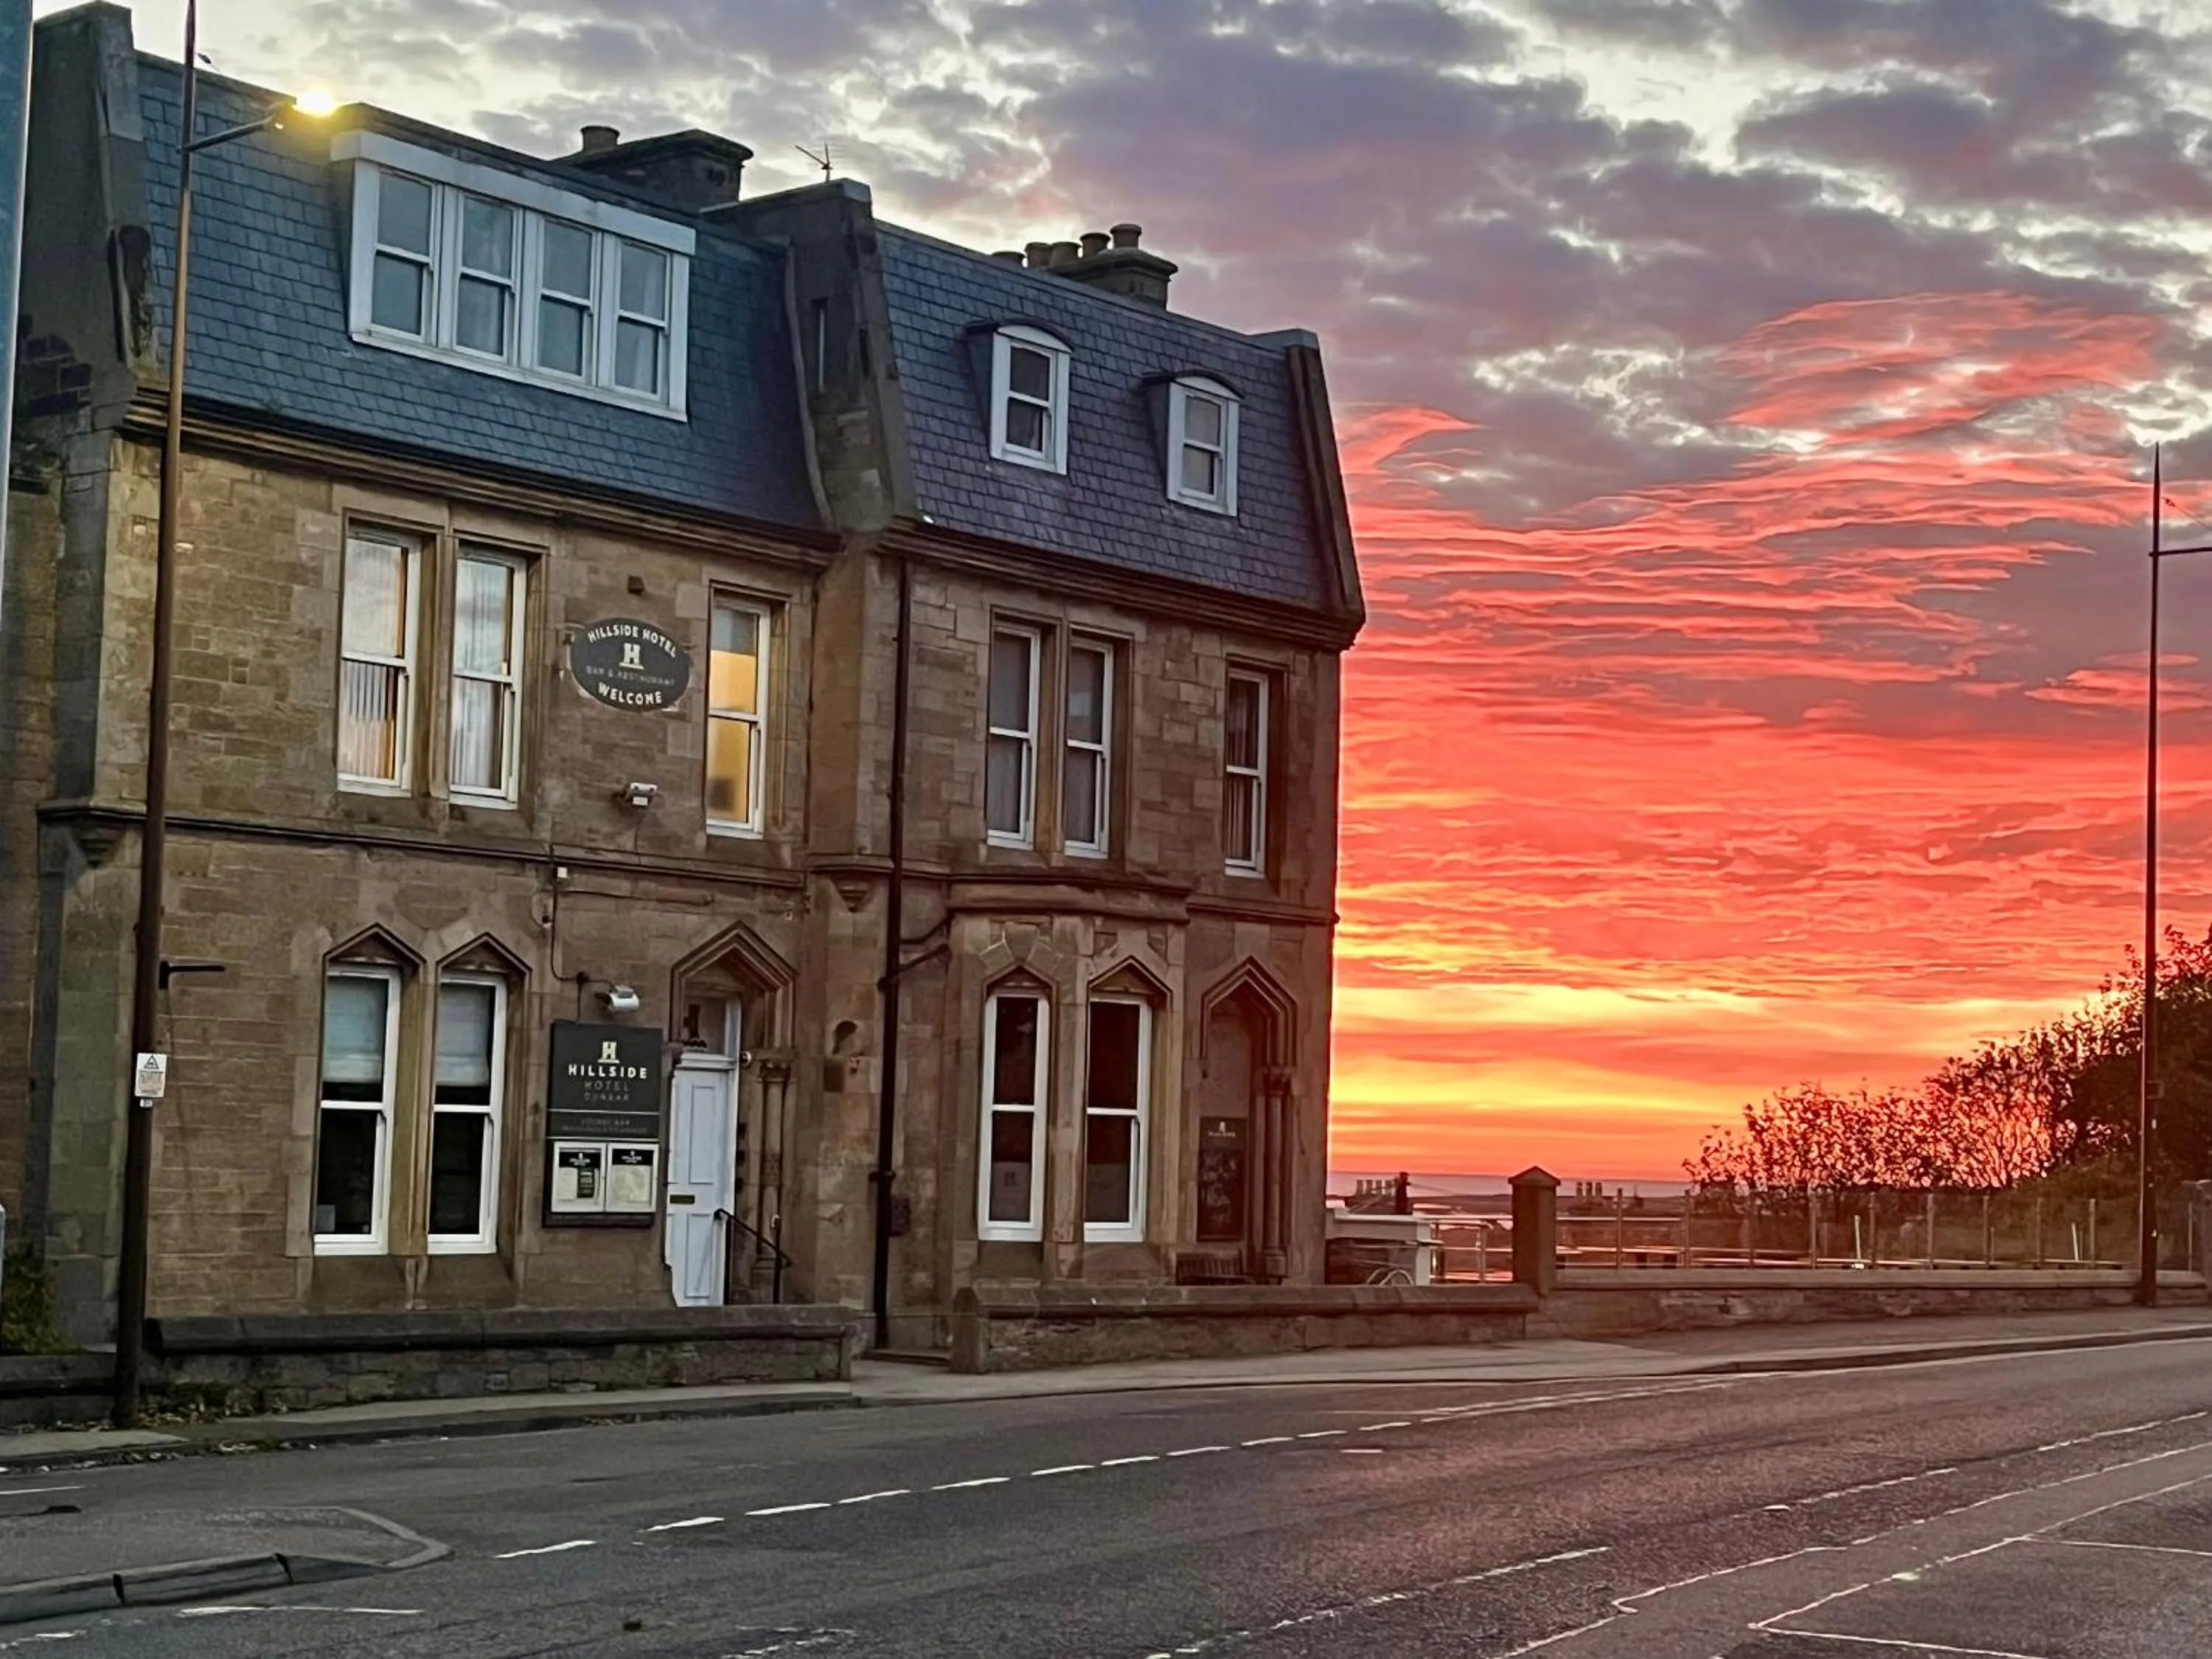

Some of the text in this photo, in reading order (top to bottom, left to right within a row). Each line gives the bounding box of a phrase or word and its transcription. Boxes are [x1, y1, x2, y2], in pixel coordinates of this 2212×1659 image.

[588, 625, 677, 658] HILLSIDE HOTEL
[598, 681, 662, 705] WELCOME
[568, 1064, 647, 1079] HILLSIDE
[585, 1080, 629, 1092] HOTEL
